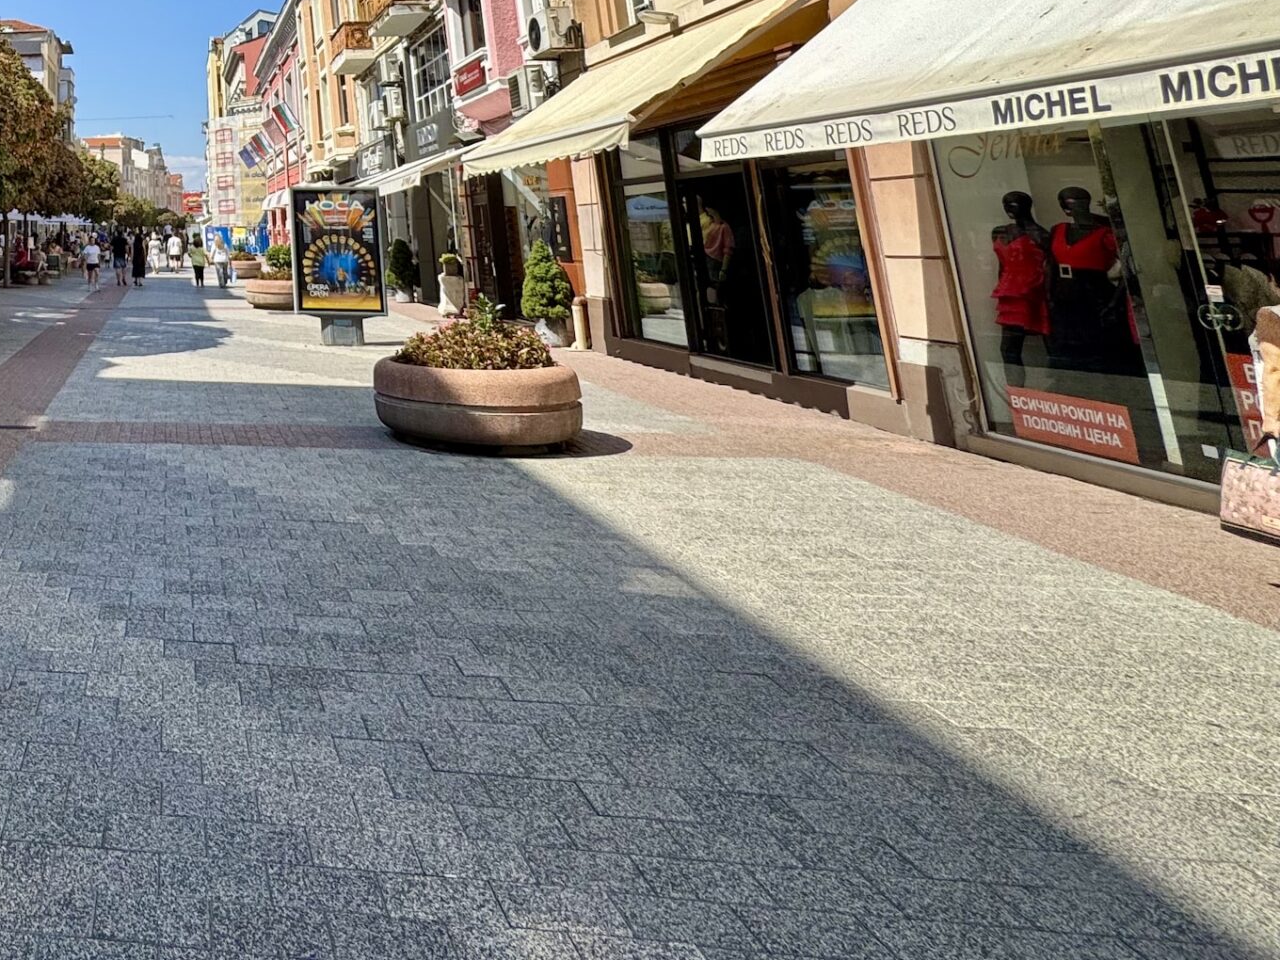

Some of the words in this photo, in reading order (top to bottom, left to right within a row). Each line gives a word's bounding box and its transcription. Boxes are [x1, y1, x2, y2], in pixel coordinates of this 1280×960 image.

[714, 135, 748, 157] REDS
[764, 128, 805, 152] REDS
[824, 119, 873, 145] REDS
[897, 107, 957, 136] REDS
[991, 85, 1112, 125] MICHEL
[305, 200, 365, 212] КОСА
[1010, 395, 1061, 416] ВСИЧКИ
[1060, 404, 1105, 425] РОКЛИ
[1107, 413, 1128, 430] НА
[1022, 414, 1081, 439] ПОЛОВИН
[1083, 427, 1123, 448] ЦЕНА
